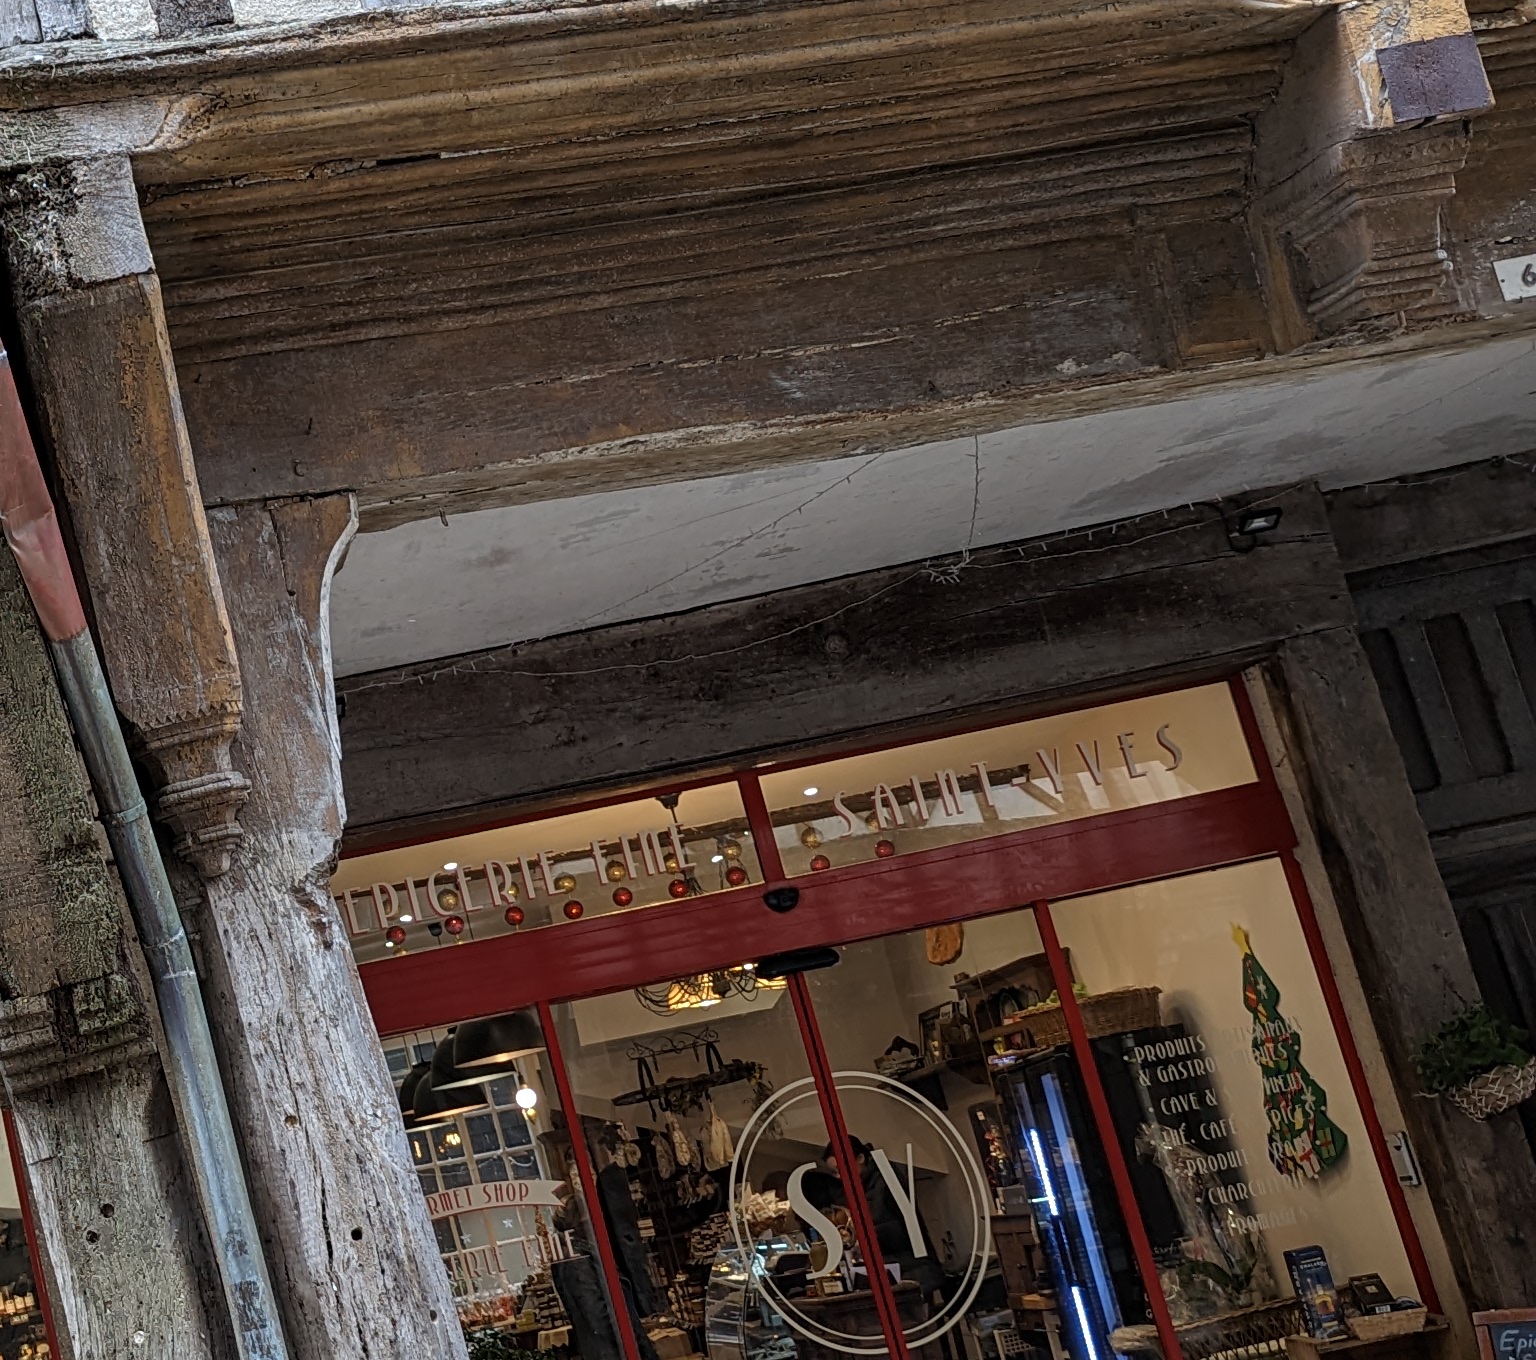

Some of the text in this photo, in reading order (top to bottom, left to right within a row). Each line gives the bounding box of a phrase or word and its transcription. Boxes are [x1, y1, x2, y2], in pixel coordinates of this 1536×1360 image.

[833, 723, 1183, 837] SAINT-YVES
[342, 823, 698, 935] EPICERIE FINE
[1133, 1034, 1206, 1064] PRODUITS
[1138, 1069, 1152, 1087] &
[1160, 1092, 1200, 1116] CAVE
[1206, 1089, 1218, 1107] &
[482, 1182, 530, 1204] SHOP
